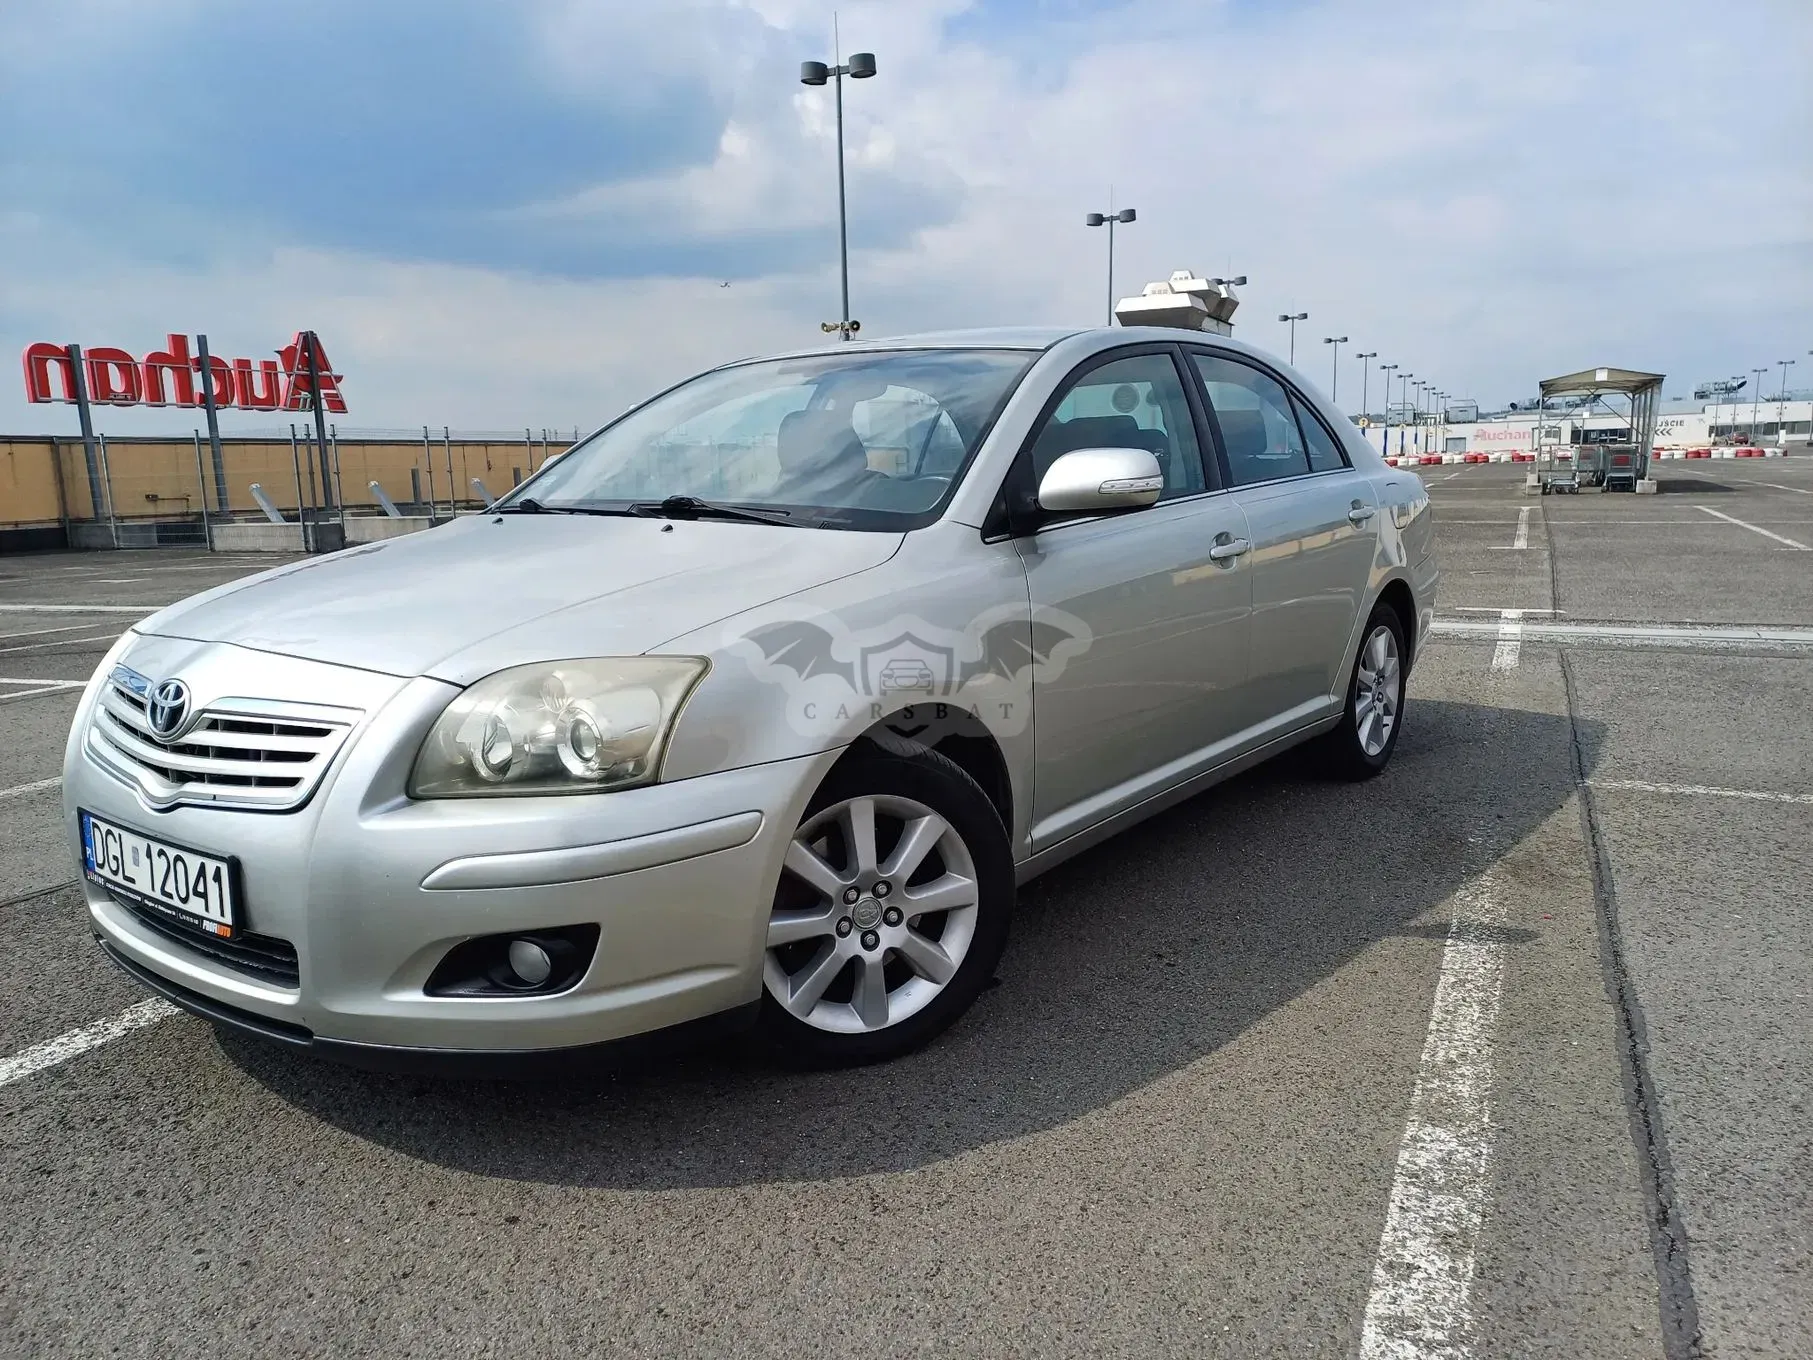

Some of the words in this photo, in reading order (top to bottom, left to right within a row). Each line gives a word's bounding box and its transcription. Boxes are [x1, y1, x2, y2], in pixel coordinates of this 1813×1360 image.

[1474, 429, 1531, 441] Auchan
[85, 845, 94, 862] PL
[92, 821, 136, 885] DGL
[145, 842, 226, 918] 12041
